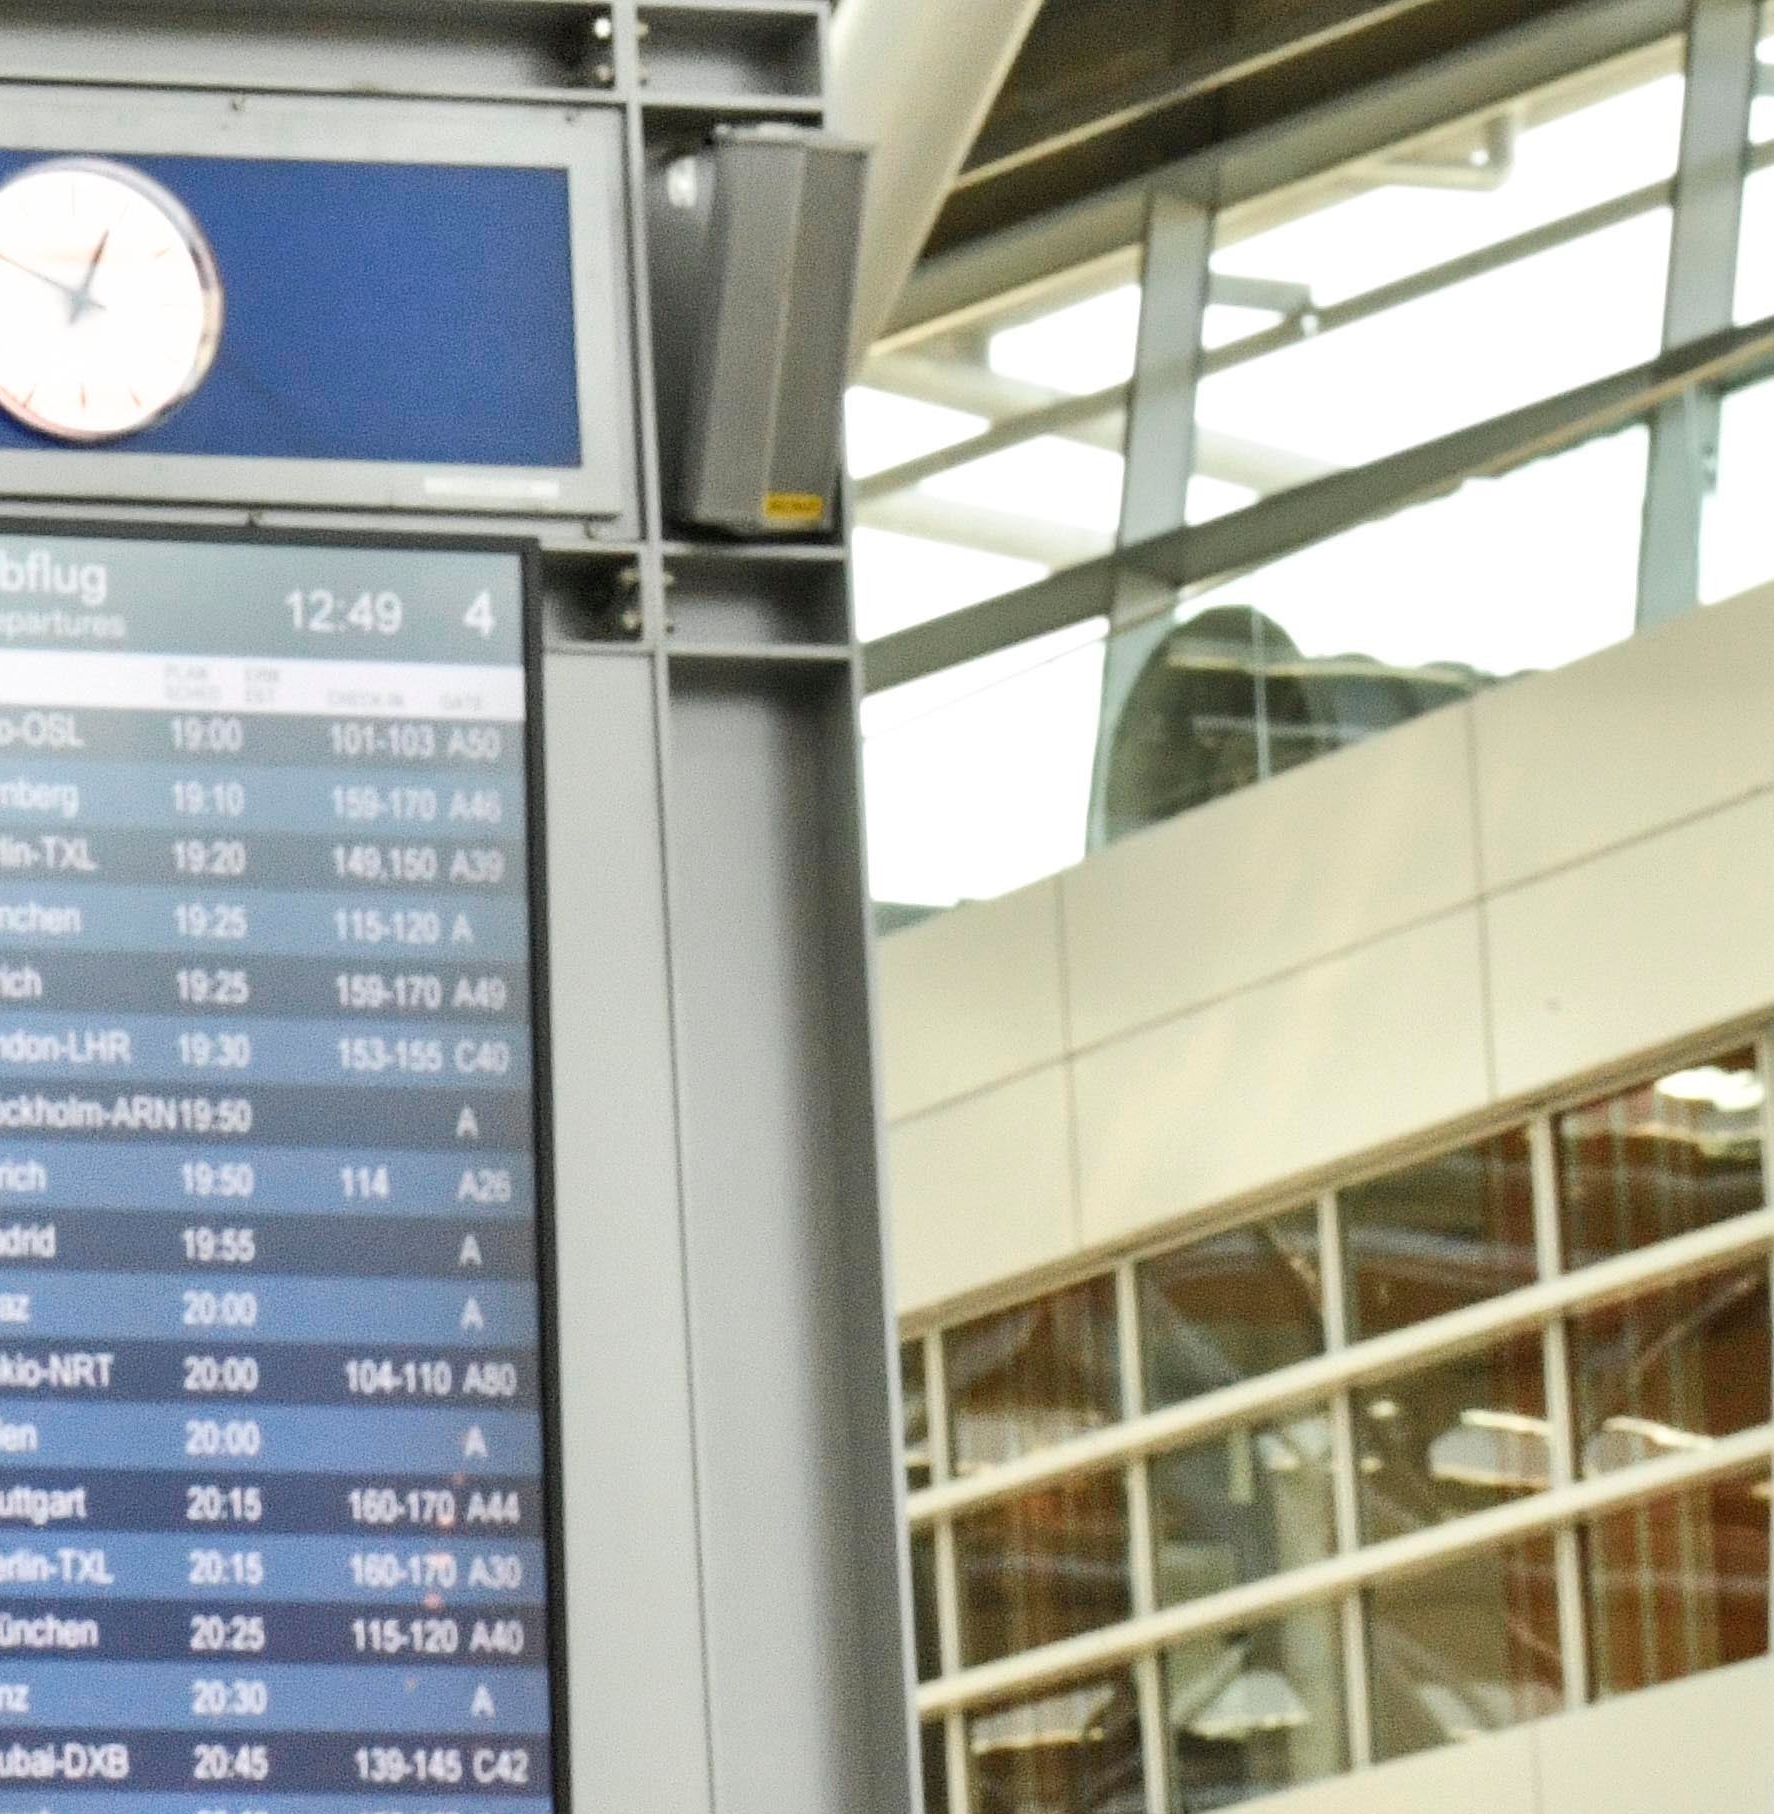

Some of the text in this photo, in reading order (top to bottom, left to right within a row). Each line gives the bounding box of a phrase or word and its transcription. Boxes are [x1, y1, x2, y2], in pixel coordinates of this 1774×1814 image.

[285, 588, 403, 635] 12:49
[463, 589, 495, 636] 4
[181, 1226, 256, 1263] 19:55
[459, 1234, 482, 1265] A
[183, 1355, 260, 1392] 20:00
[345, 1358, 452, 1395] 104-110
[189, 1614, 266, 1652] 20:25
[352, 1618, 459, 1654] 115-120
[469, 1620, 524, 1655] A40
[191, 1678, 268, 1715] 20:30
[470, 1684, 495, 1717] A
